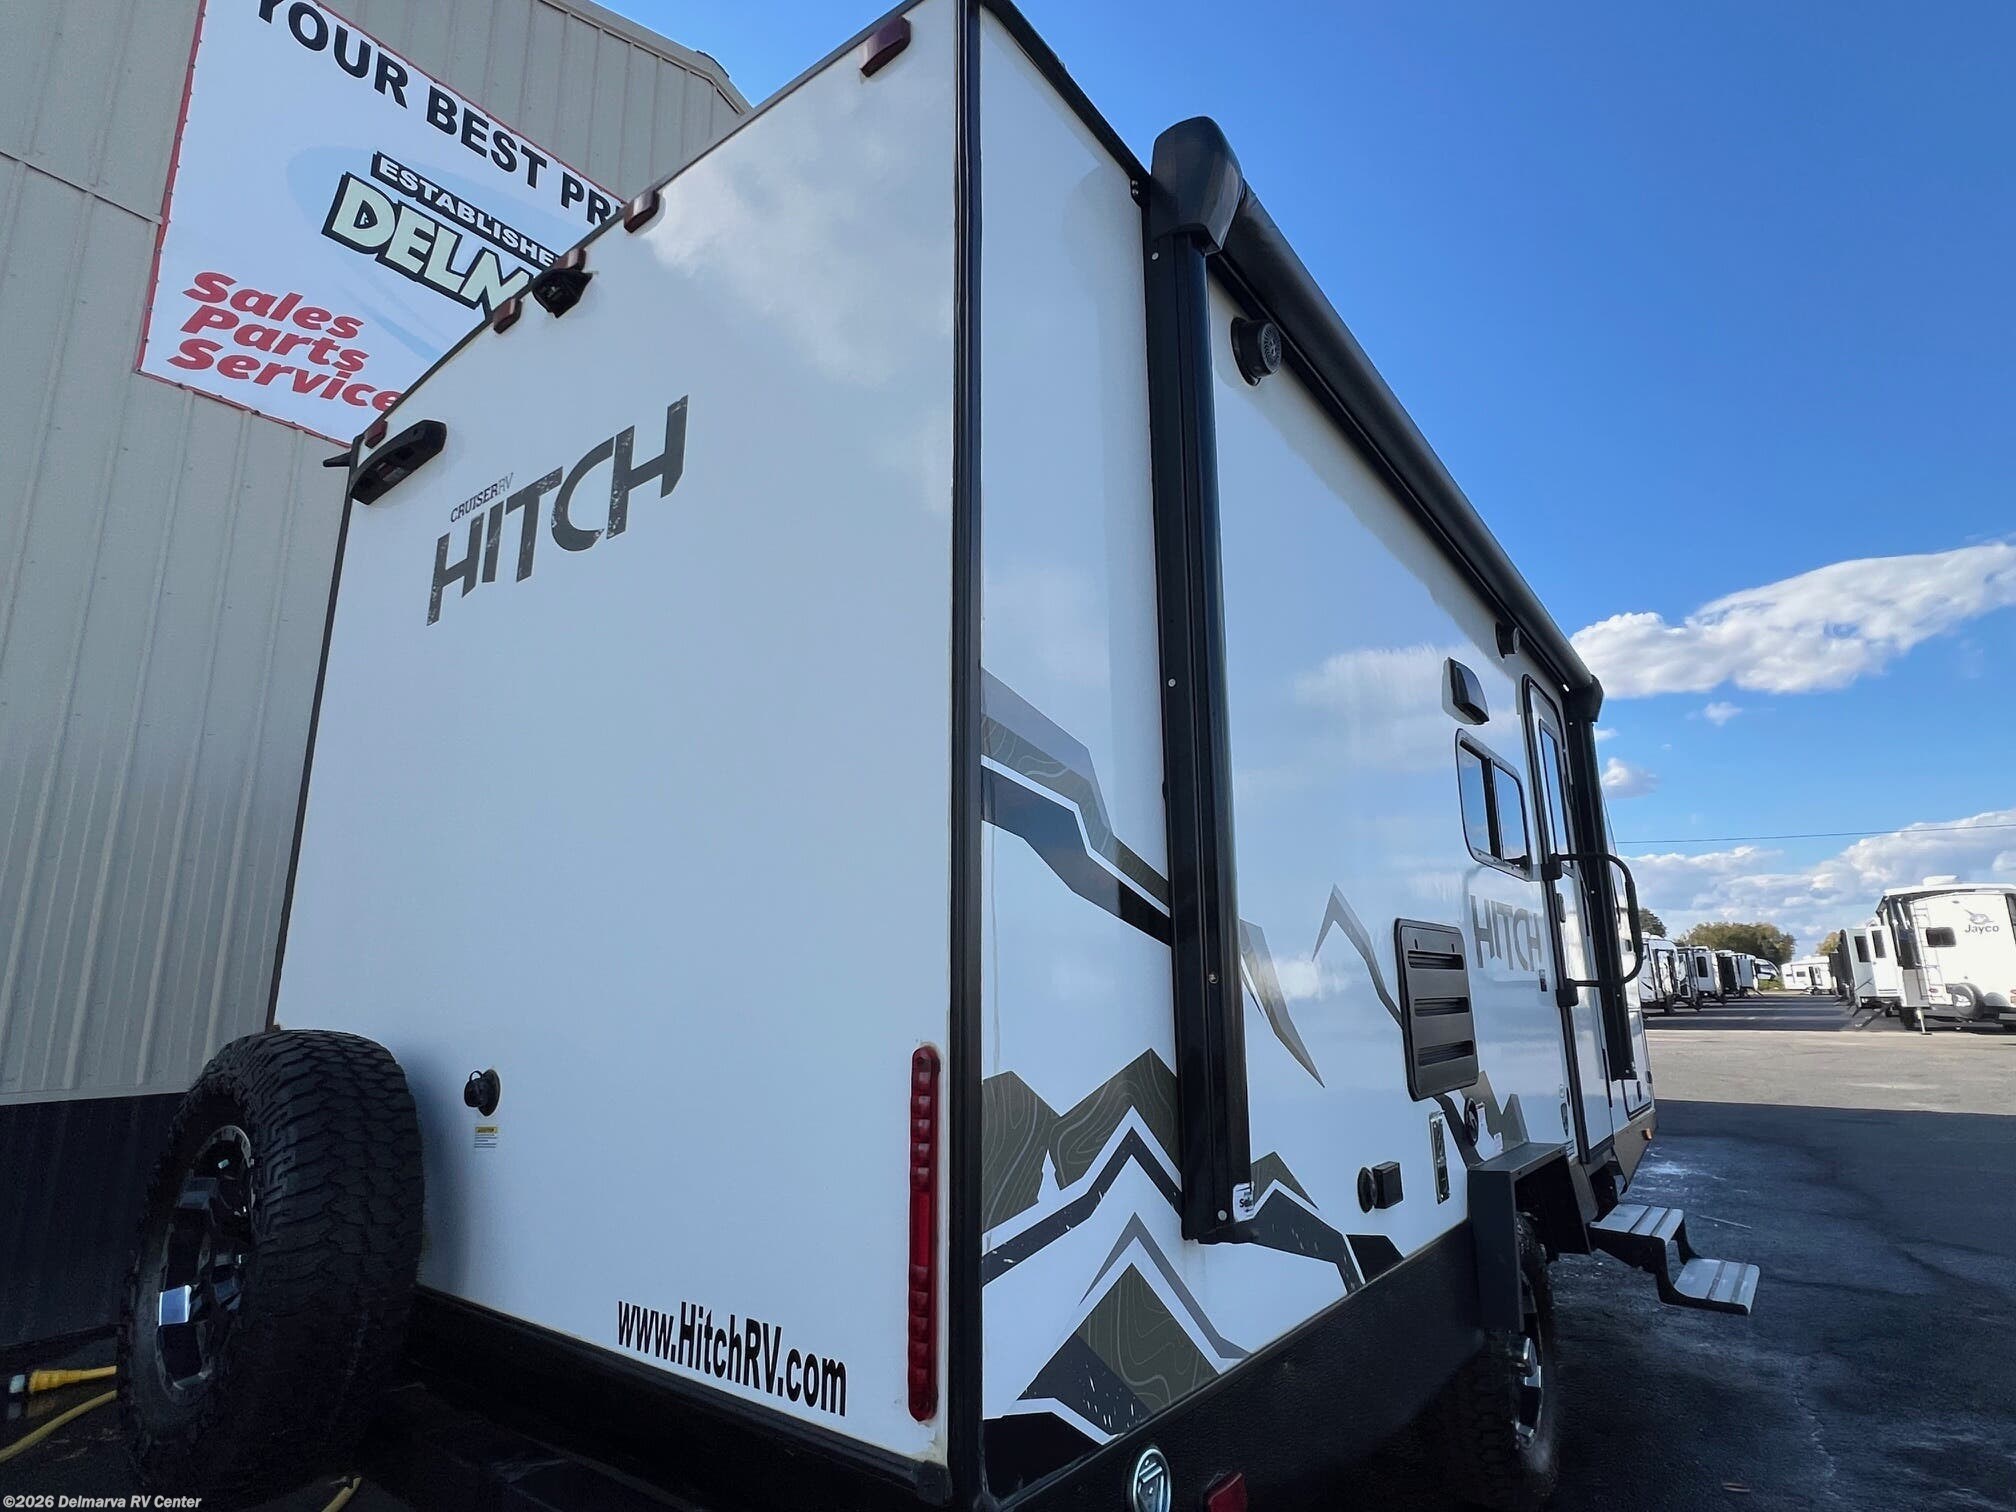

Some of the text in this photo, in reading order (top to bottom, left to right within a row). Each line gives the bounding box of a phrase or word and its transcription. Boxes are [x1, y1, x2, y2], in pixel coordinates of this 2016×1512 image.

[426, 85, 548, 189] BEST
[560, 171, 625, 226] PR
[375, 153, 560, 268] ESTABLISHE
[180, 304, 370, 372] Parts
[182, 271, 364, 339] Sales
[166, 338, 403, 412] Service
[426, 394, 689, 626] HITCH
[1469, 894, 1544, 972] HITCH
[1964, 924, 2000, 936] Jayco
[617, 1300, 847, 1417] www.HitchRV.com
